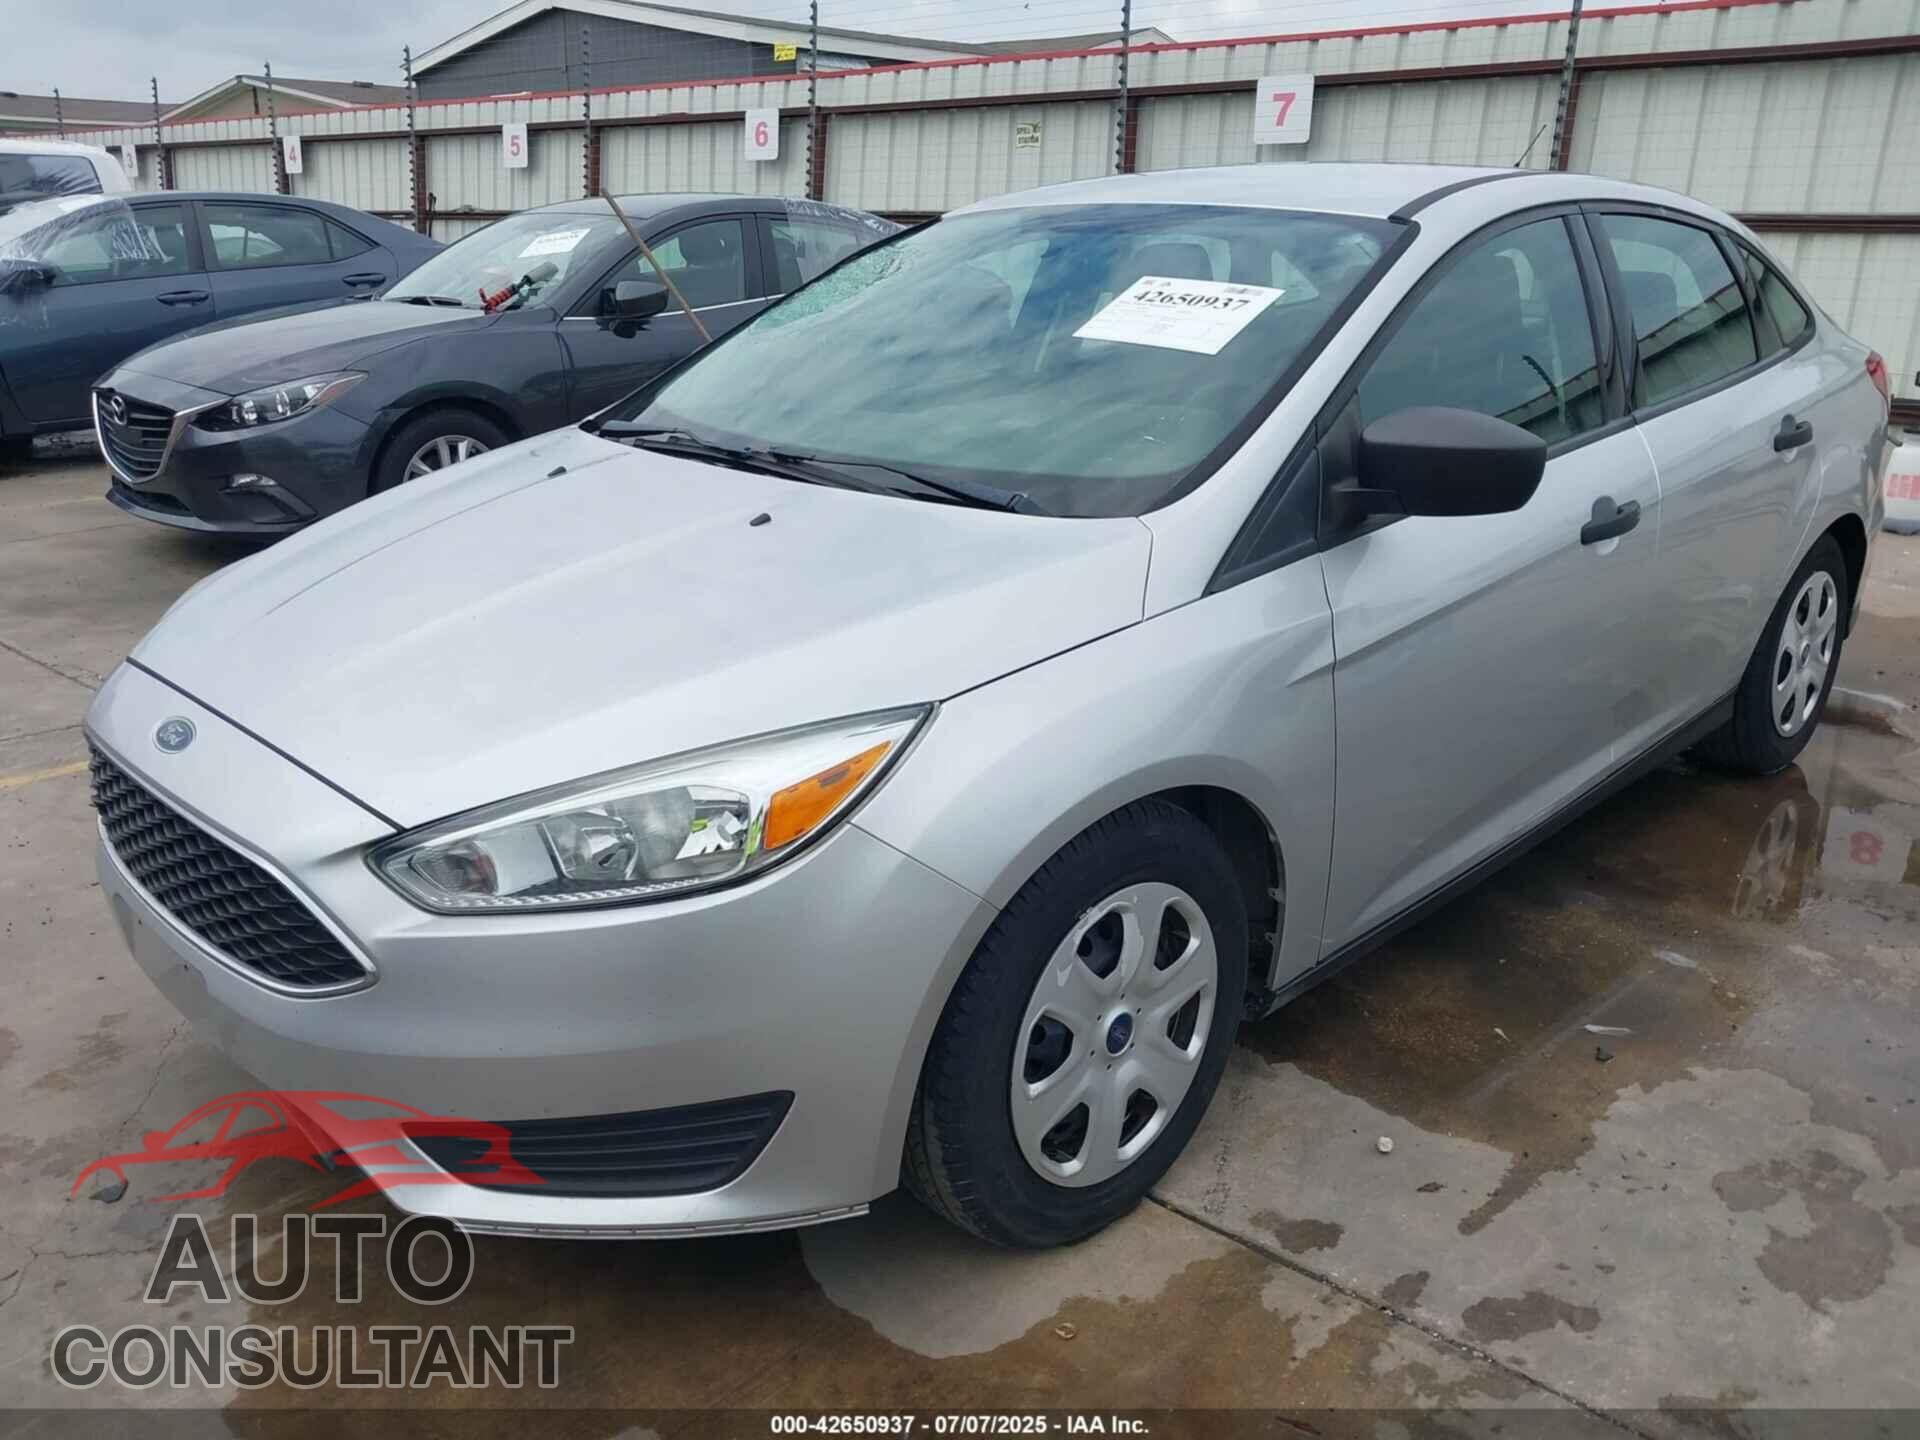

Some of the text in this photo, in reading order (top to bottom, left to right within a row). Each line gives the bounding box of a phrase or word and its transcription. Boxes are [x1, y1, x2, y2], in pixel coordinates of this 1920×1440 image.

[1272, 92, 1297, 127] 7
[510, 134, 521, 157] 5
[755, 120, 769, 148] 6
[288, 145, 297, 164] 4
[1133, 289, 1250, 312] 42650937
